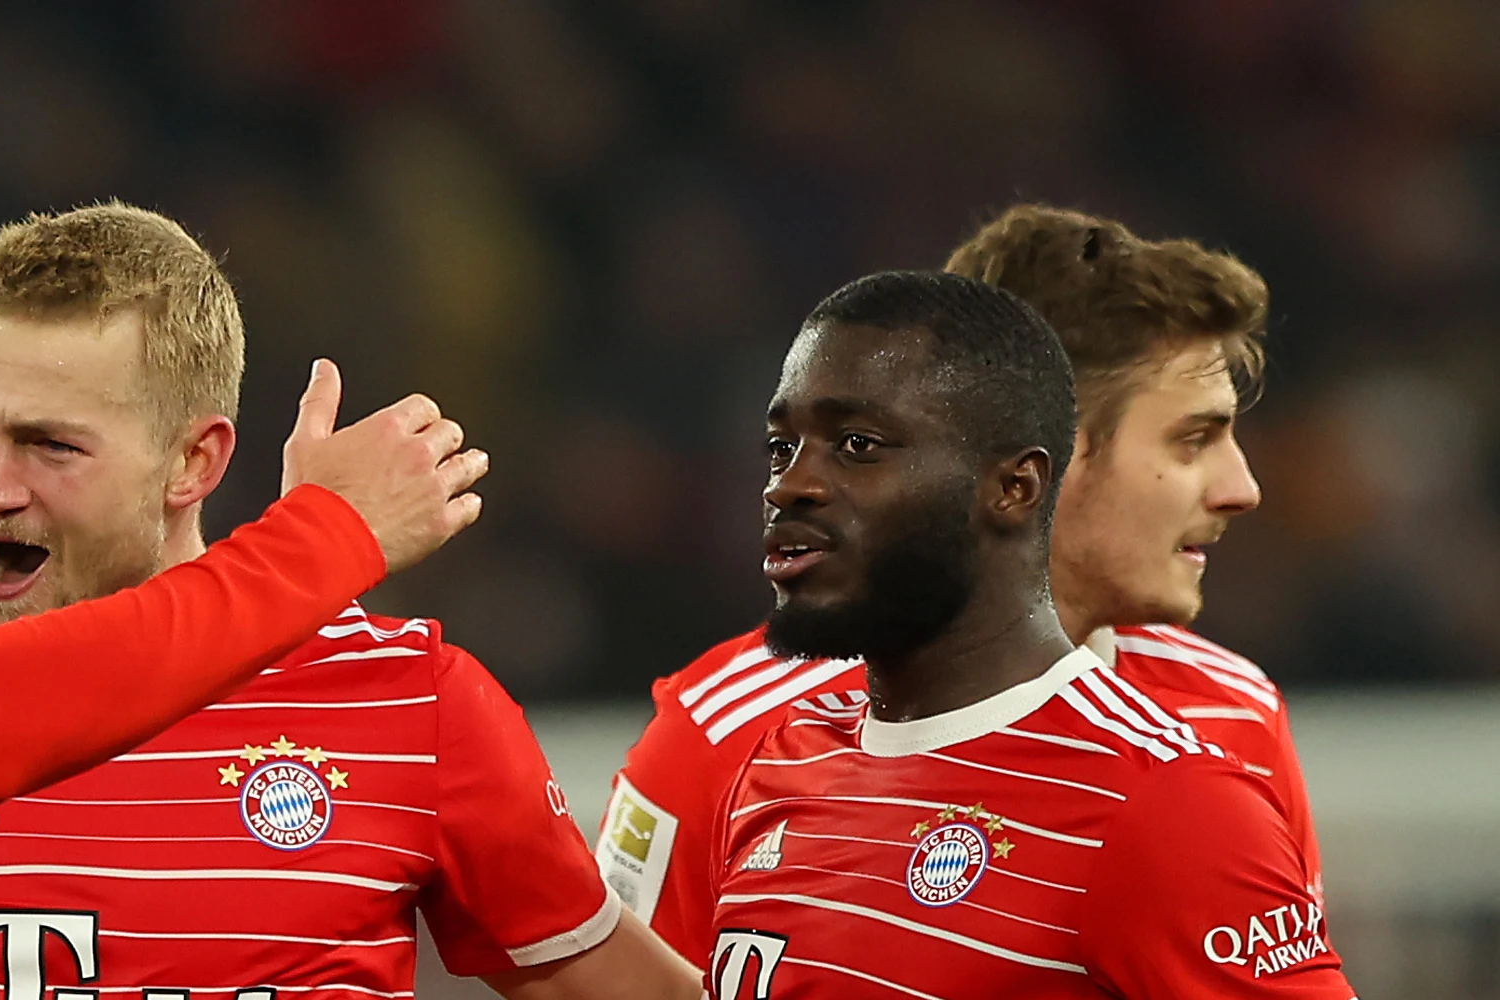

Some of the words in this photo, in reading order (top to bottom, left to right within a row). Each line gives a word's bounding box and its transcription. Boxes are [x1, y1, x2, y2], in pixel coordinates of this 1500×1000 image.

[248, 779, 266, 799] FC
[265, 767, 324, 802] BAYERN
[921, 835, 940, 853] FC
[944, 829, 982, 865] BAYERN
